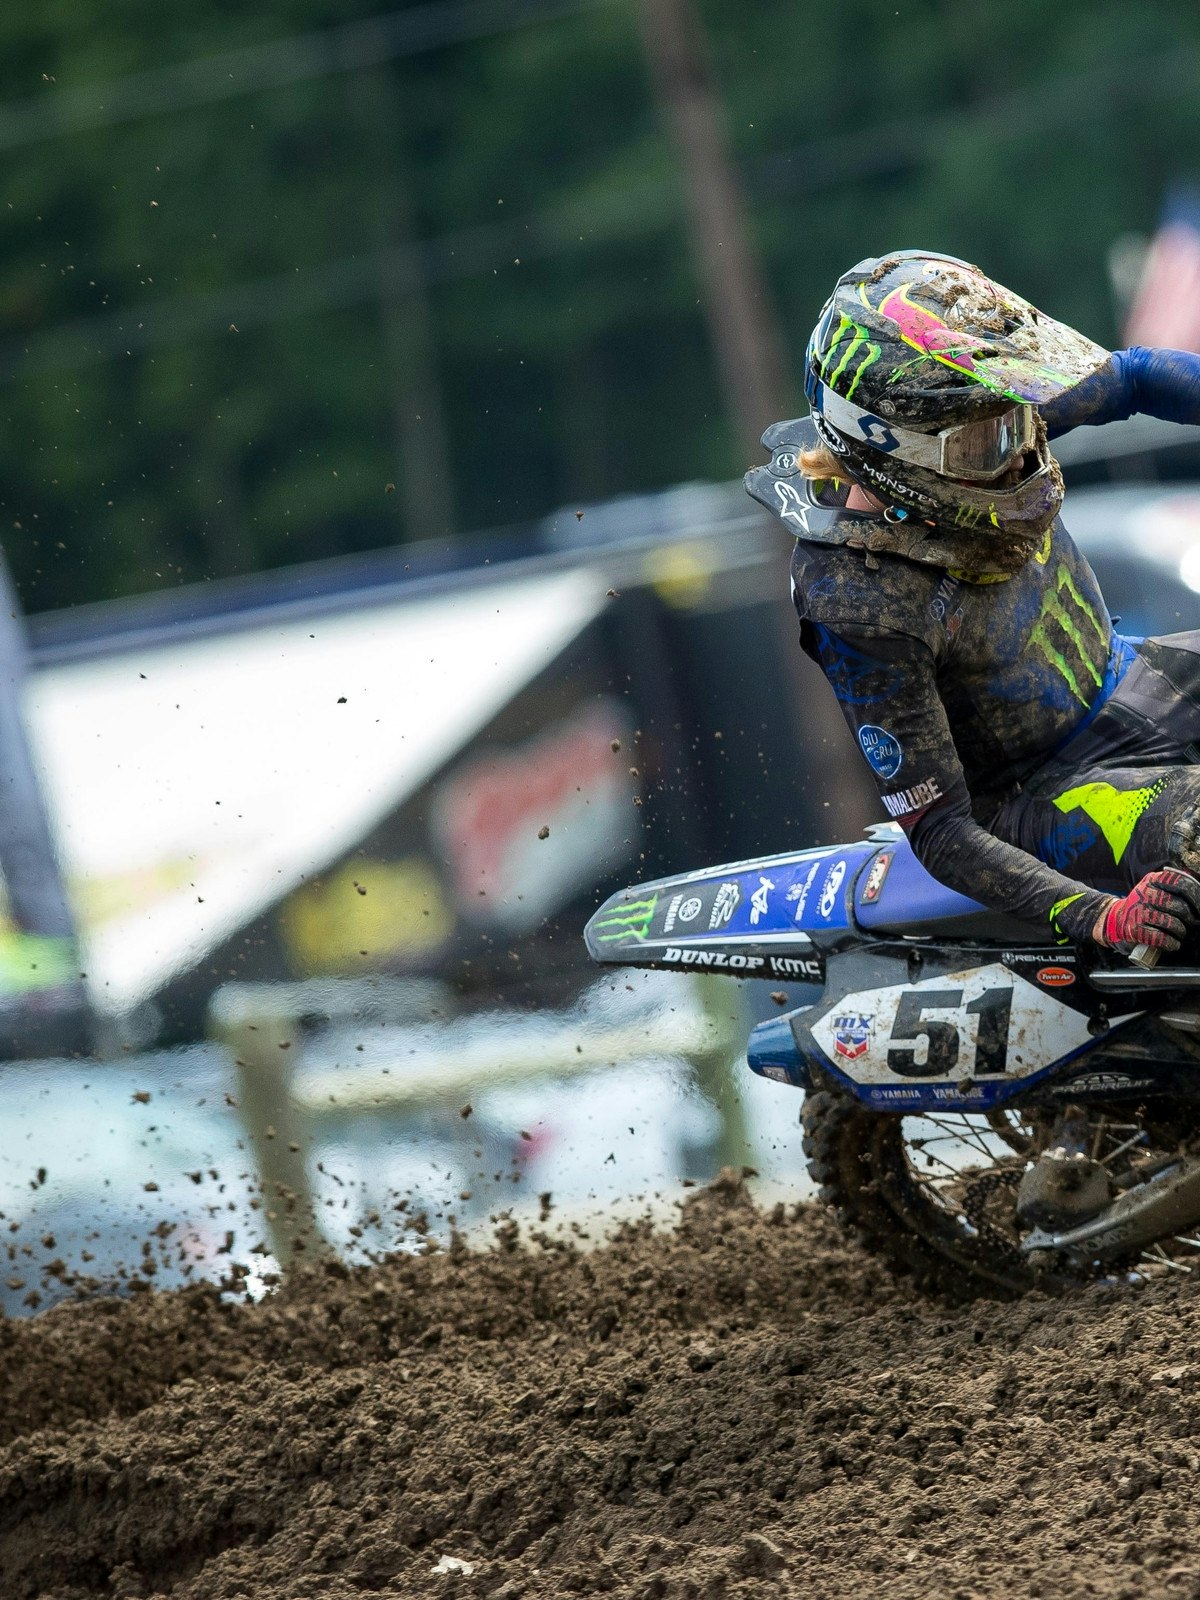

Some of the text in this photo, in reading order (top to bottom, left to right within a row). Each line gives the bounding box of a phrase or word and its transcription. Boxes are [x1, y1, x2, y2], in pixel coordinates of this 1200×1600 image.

[863, 462, 939, 508] MONSTER
[663, 893, 684, 934] YAMAHA
[662, 947, 764, 969] DUNLOP
[1014, 954, 1076, 963] REKLUSE
[886, 986, 1014, 1077] 51
[881, 1089, 921, 1099] YAMAHA
